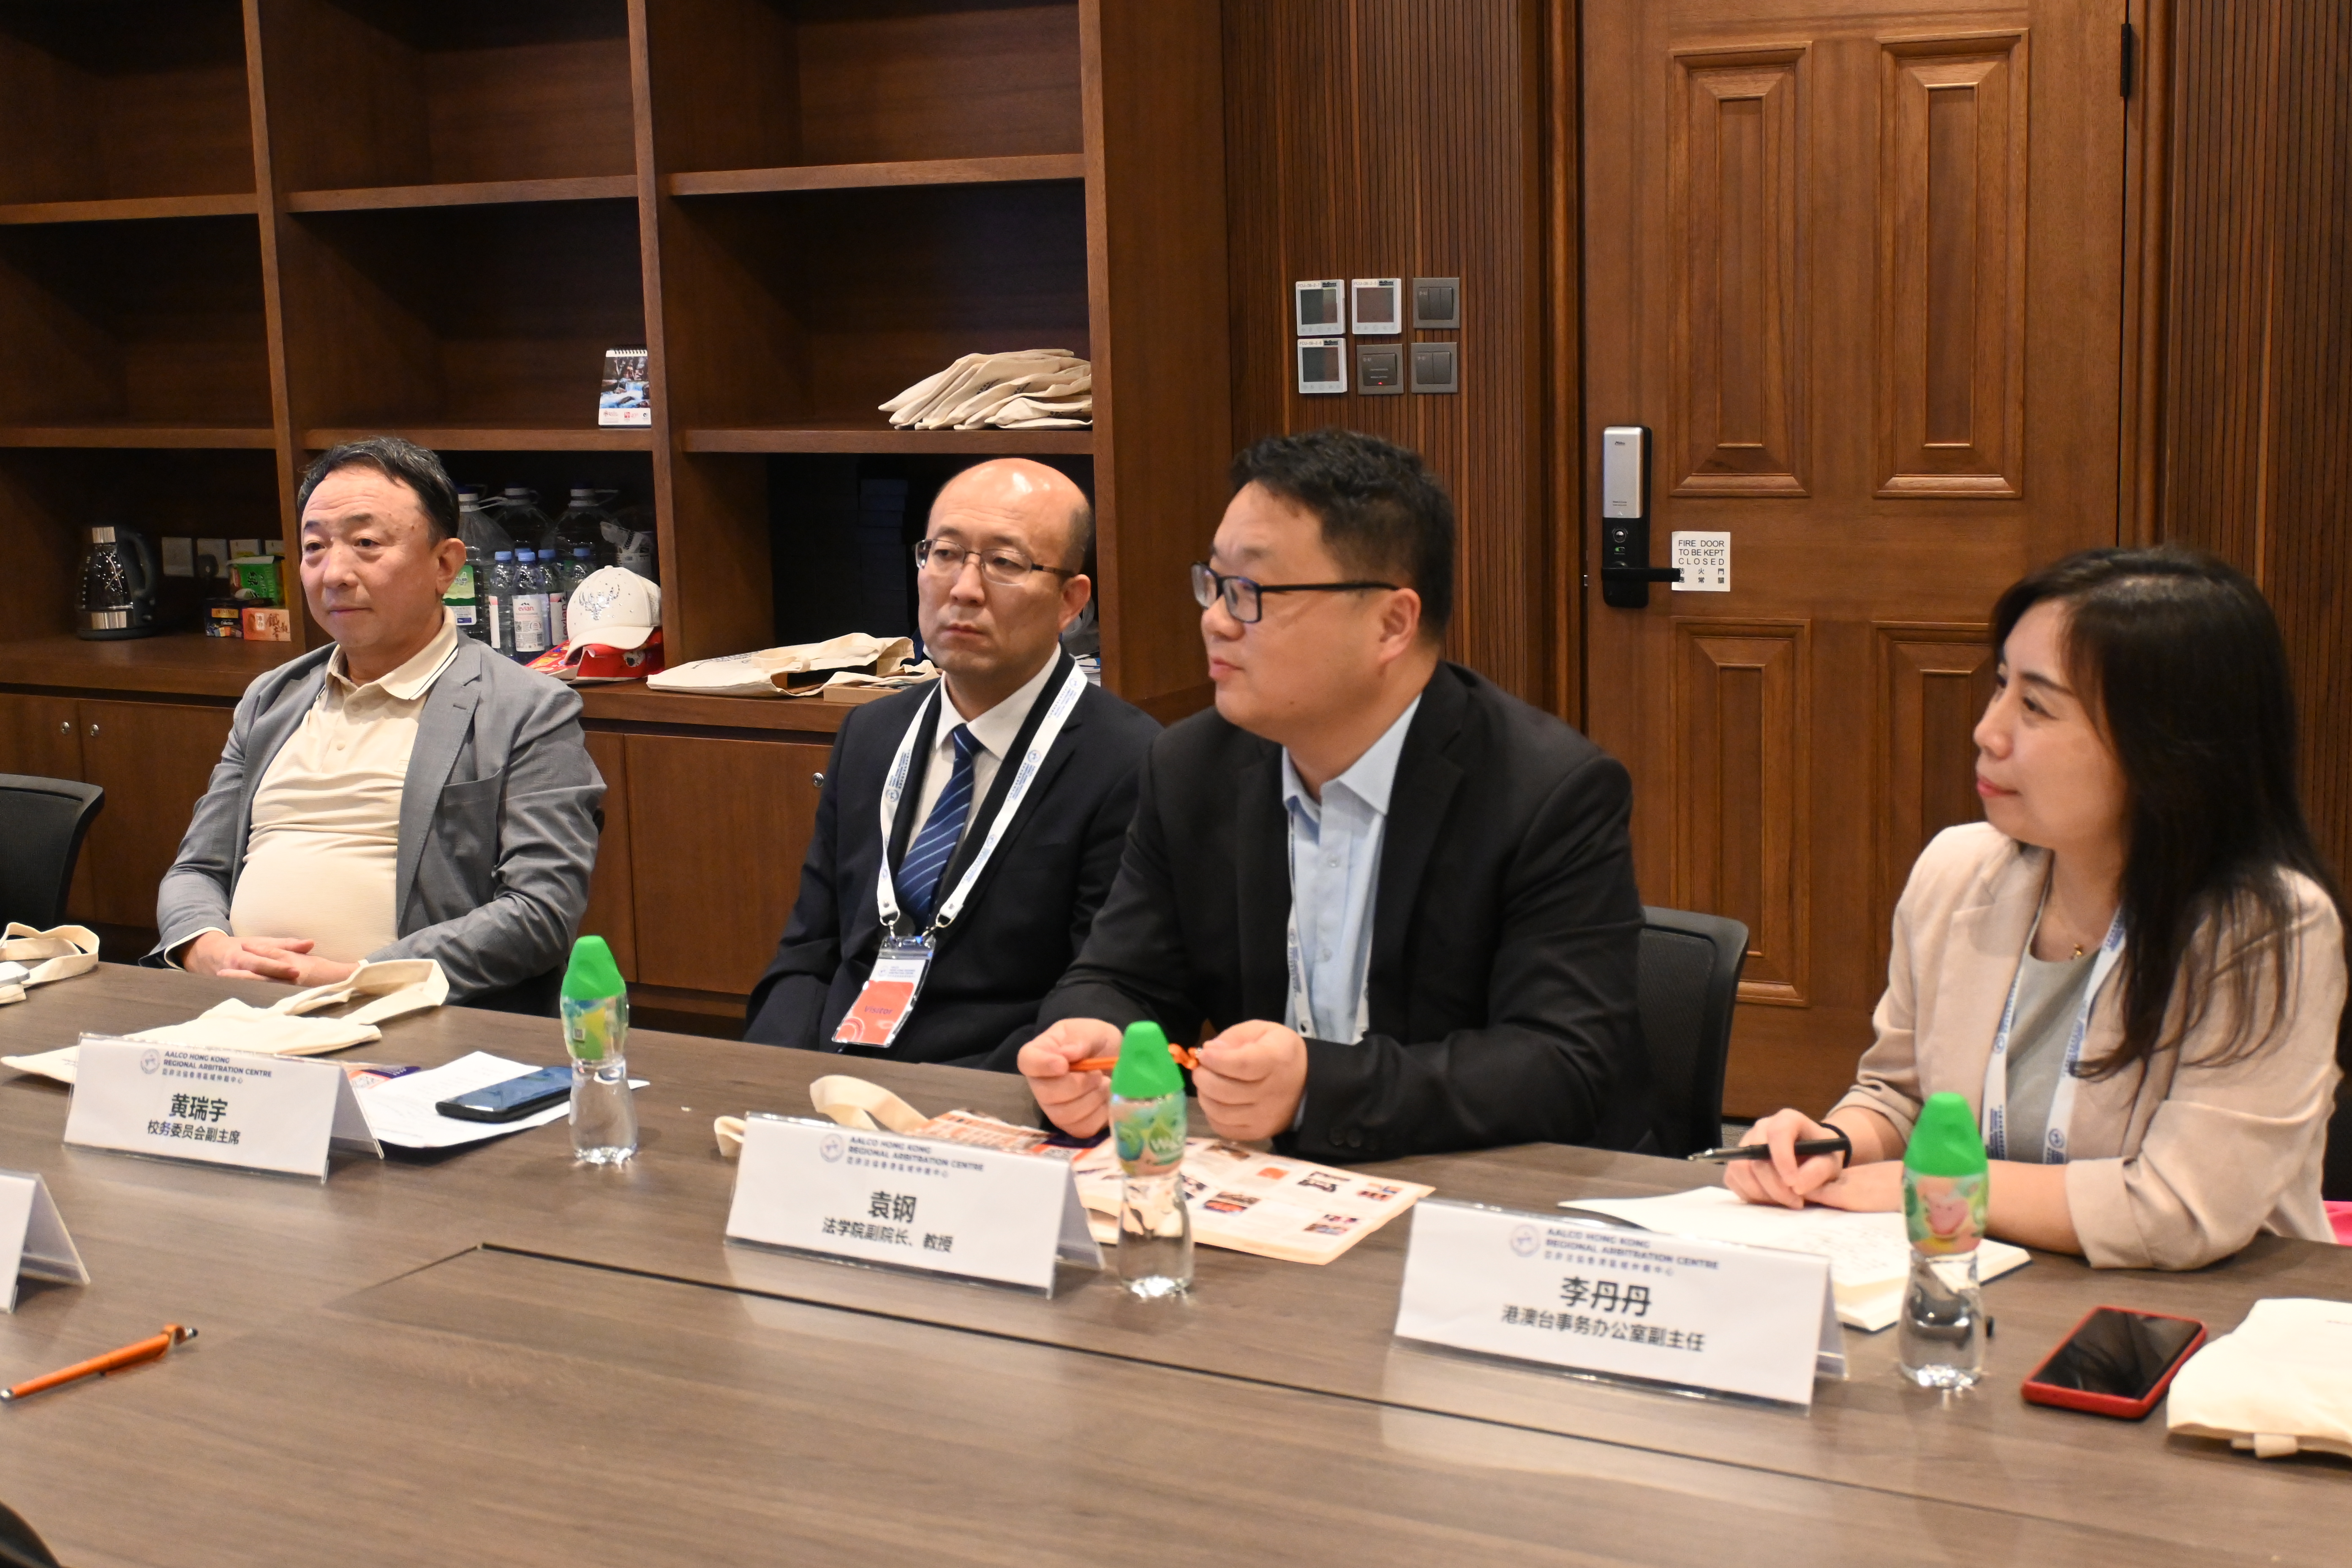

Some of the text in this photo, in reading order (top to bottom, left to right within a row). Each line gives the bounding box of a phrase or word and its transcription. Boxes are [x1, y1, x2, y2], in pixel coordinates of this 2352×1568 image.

[163, 1059, 272, 1078] REGIONAL ARBITRATION CENTRE
[165, 1051, 230, 1064] AALCO HONG KONG
[169, 1093, 229, 1122] 黄瑞宇
[147, 1119, 240, 1145] 校务委员会副主席
[848, 1146, 984, 1171] REGIONAL ARBITRATION CENTRE
[881, 1140, 904, 1150] HONG
[907, 1144, 931, 1154] KONG
[868, 1191, 917, 1223] 袁钢
[822, 1217, 954, 1253] 法学院副院长、教授
[1586, 1233, 1616, 1244] HONG
[1620, 1237, 1650, 1249] KONG
[1546, 1239, 1719, 1269] REGIONAL ARBITRATION CENTRE
[1560, 1275, 1651, 1318] 李丹丹
[1500, 1304, 1706, 1353] 港澳台事务办公室副主任
